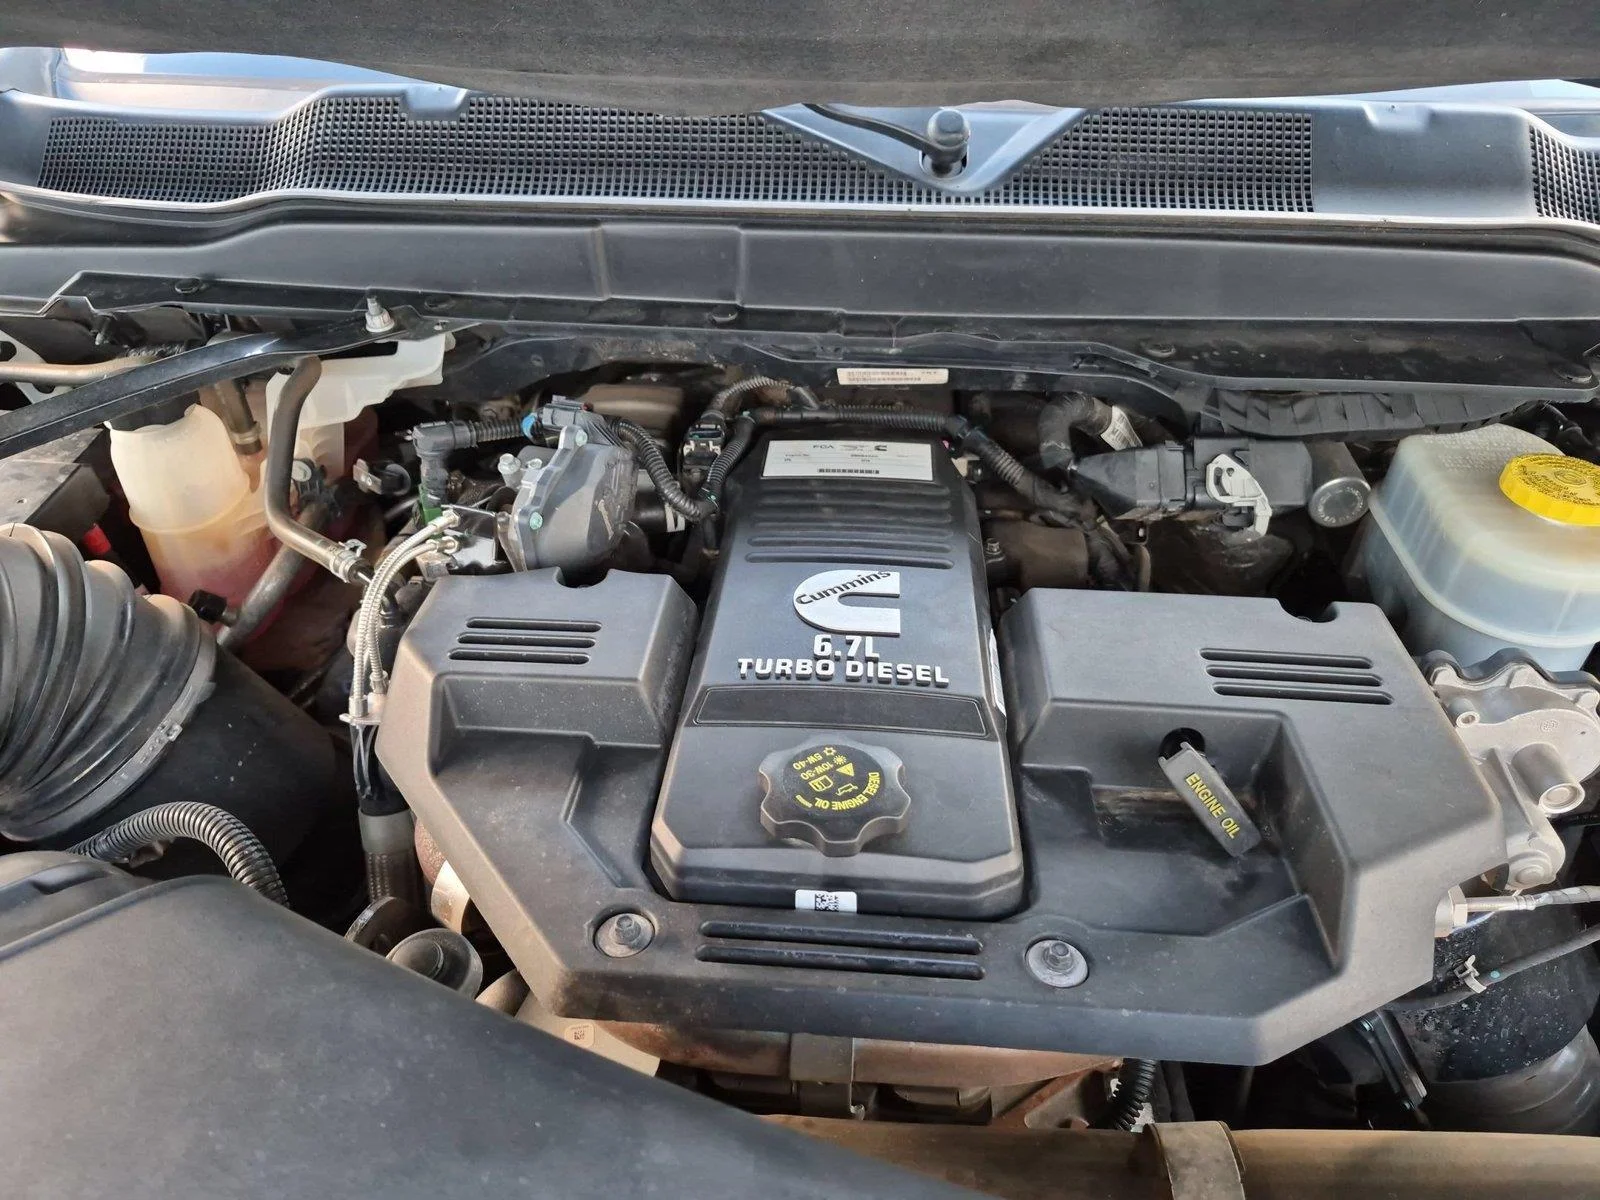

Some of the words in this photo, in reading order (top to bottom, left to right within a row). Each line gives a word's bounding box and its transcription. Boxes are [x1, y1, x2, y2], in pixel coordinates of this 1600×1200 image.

[795, 570, 891, 606] Cummins
[813, 634, 880, 662] 6.7L
[738, 658, 836, 680] TURBO
[845, 660, 950, 688] DIESEL
[793, 753, 823, 770] 5W-40
[800, 761, 834, 780] 10W-30
[862, 771, 880, 796] DIESEL
[814, 797, 830, 809] OIL
[831, 793, 869, 810] ENGINE
[1185, 772, 1227, 819] ENGINE
[1220, 817, 1241, 839] OIL
